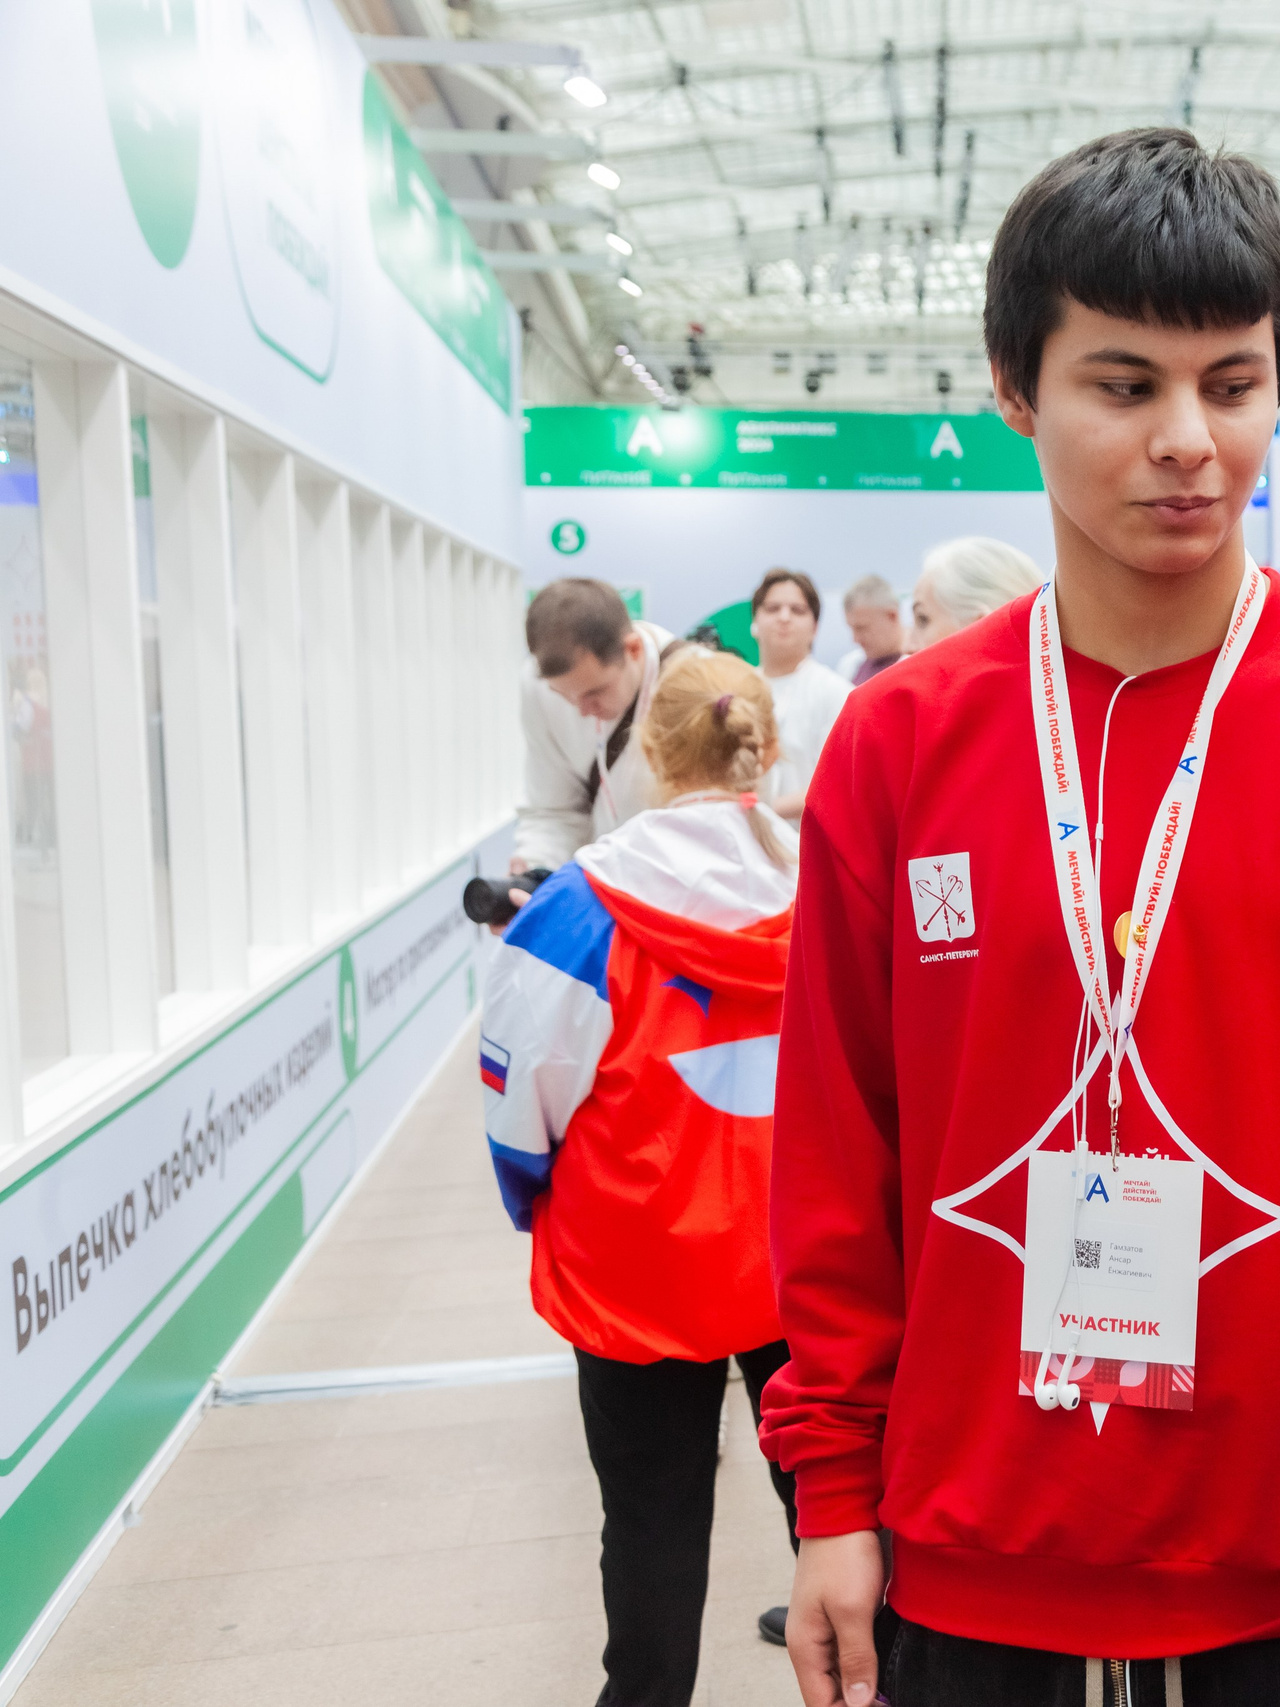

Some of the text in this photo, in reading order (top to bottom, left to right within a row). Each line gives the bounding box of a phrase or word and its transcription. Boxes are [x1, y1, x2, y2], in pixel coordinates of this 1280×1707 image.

[1233, 571, 1260, 635] ПОБЕЖДАЙ!
[1040, 604, 1070, 794] МЕЧТАЙ! ДЕЙСТВУЙ! ПОБЕЖДАЙ!
[1067, 850, 1086, 904] МЕЧТАЙ!
[1129, 952, 1146, 1009] МЕЧТАЙ!
[1155, 800, 1182, 880] ПОБЕЖДАЙ!
[919, 949, 980, 963] САНКТ-ПЕТЕРБУРГ
[1122, 1187, 1157, 1195] ДЕЙСТВУЙ!
[1122, 1195, 1162, 1204] ПОБЕЖДАЙ!
[11, 1188, 138, 1356] Выпечка
[143, 1060, 284, 1232] хлебобулочных
[1109, 1254, 1131, 1265] Ансар
[1110, 1242, 1143, 1253] Гамзатов
[1059, 1313, 1161, 1338] УЧАСТНИК
